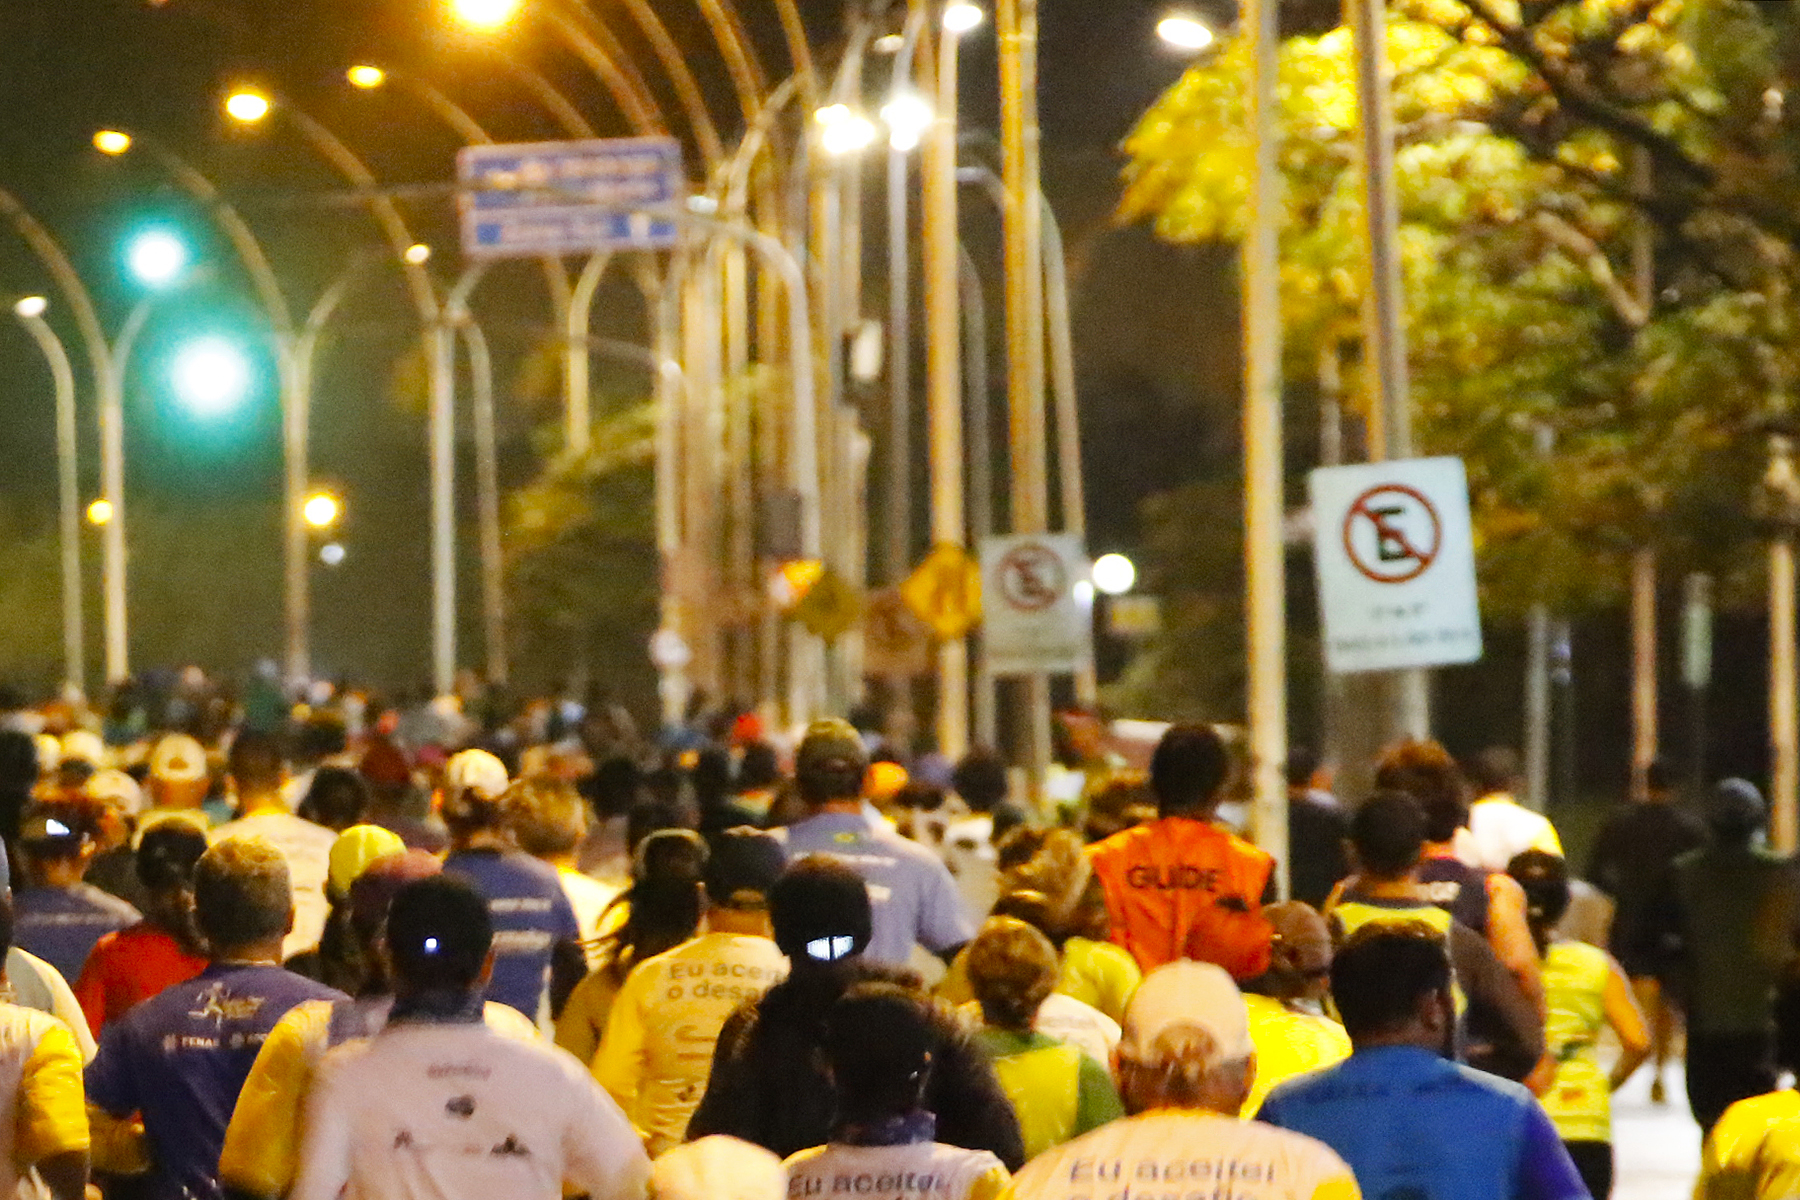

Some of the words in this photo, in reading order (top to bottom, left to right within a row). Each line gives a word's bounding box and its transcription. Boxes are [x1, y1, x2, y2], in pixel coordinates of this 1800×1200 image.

[1125, 865, 1222, 893] GUIDE
[670, 963, 704, 980] Eu
[667, 985, 684, 1001] o
[1069, 1158, 1122, 1184] Eu
[1135, 1157, 1275, 1184] aceitei
[788, 1174, 822, 1198] Eu
